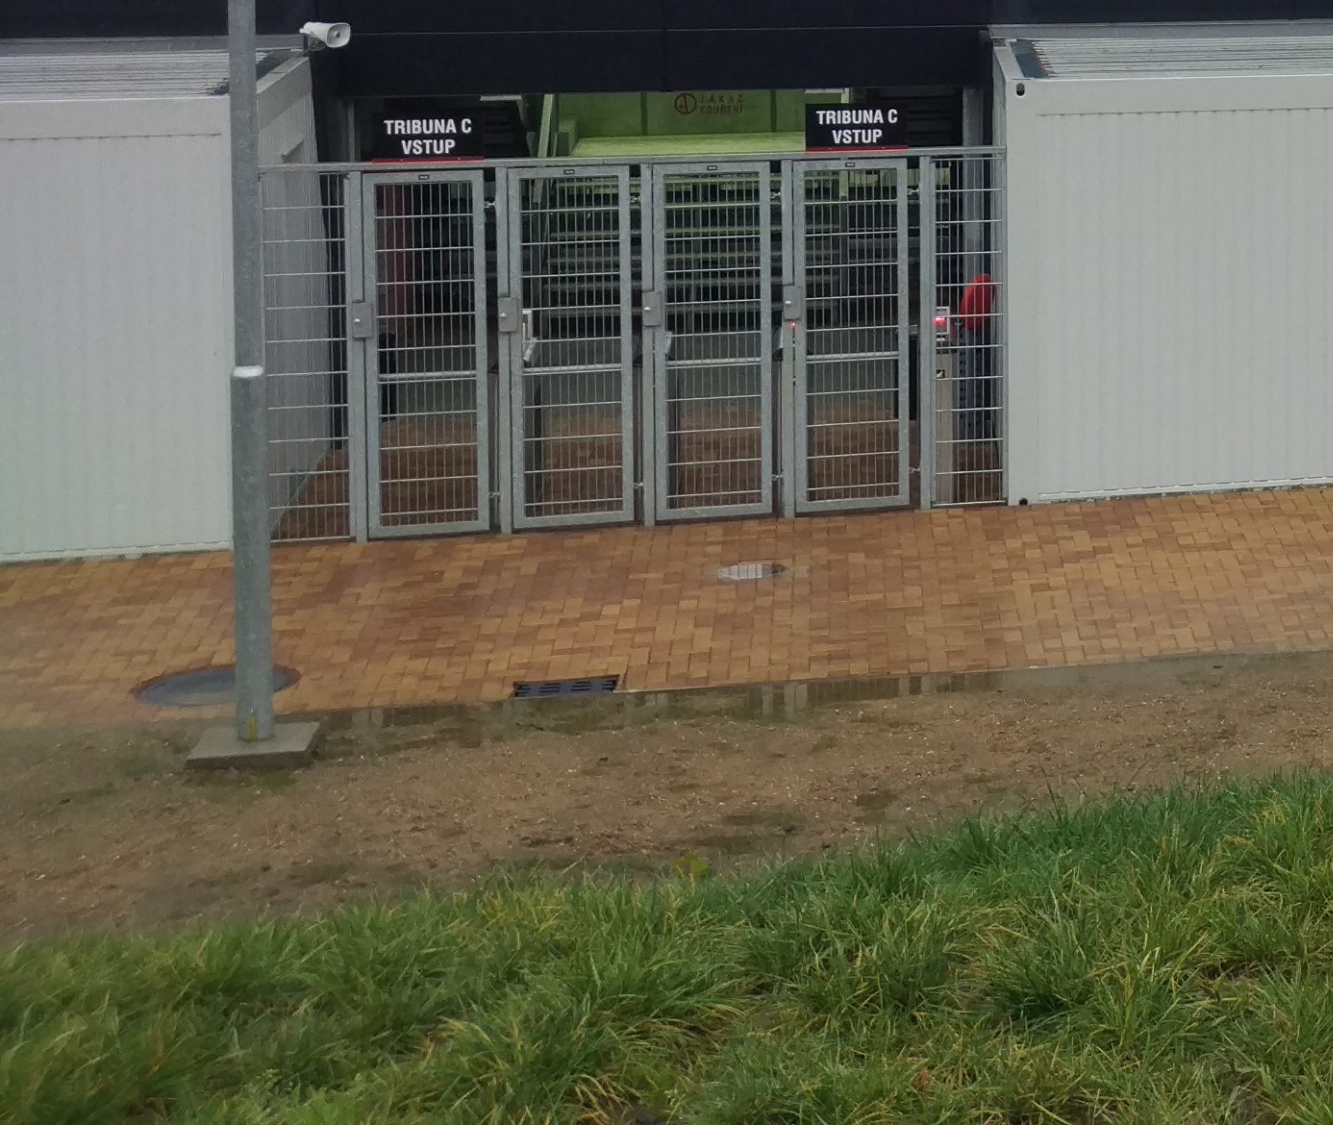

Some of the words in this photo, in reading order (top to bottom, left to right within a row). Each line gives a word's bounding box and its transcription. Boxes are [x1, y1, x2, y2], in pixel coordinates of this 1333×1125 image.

[816, 109, 884, 125] TRIBUNA
[887, 108, 898, 124] C
[383, 119, 457, 135] TRIBUNA
[461, 118, 472, 134] C
[831, 129, 883, 144] VSTUP
[401, 139, 456, 155] VSTUP
